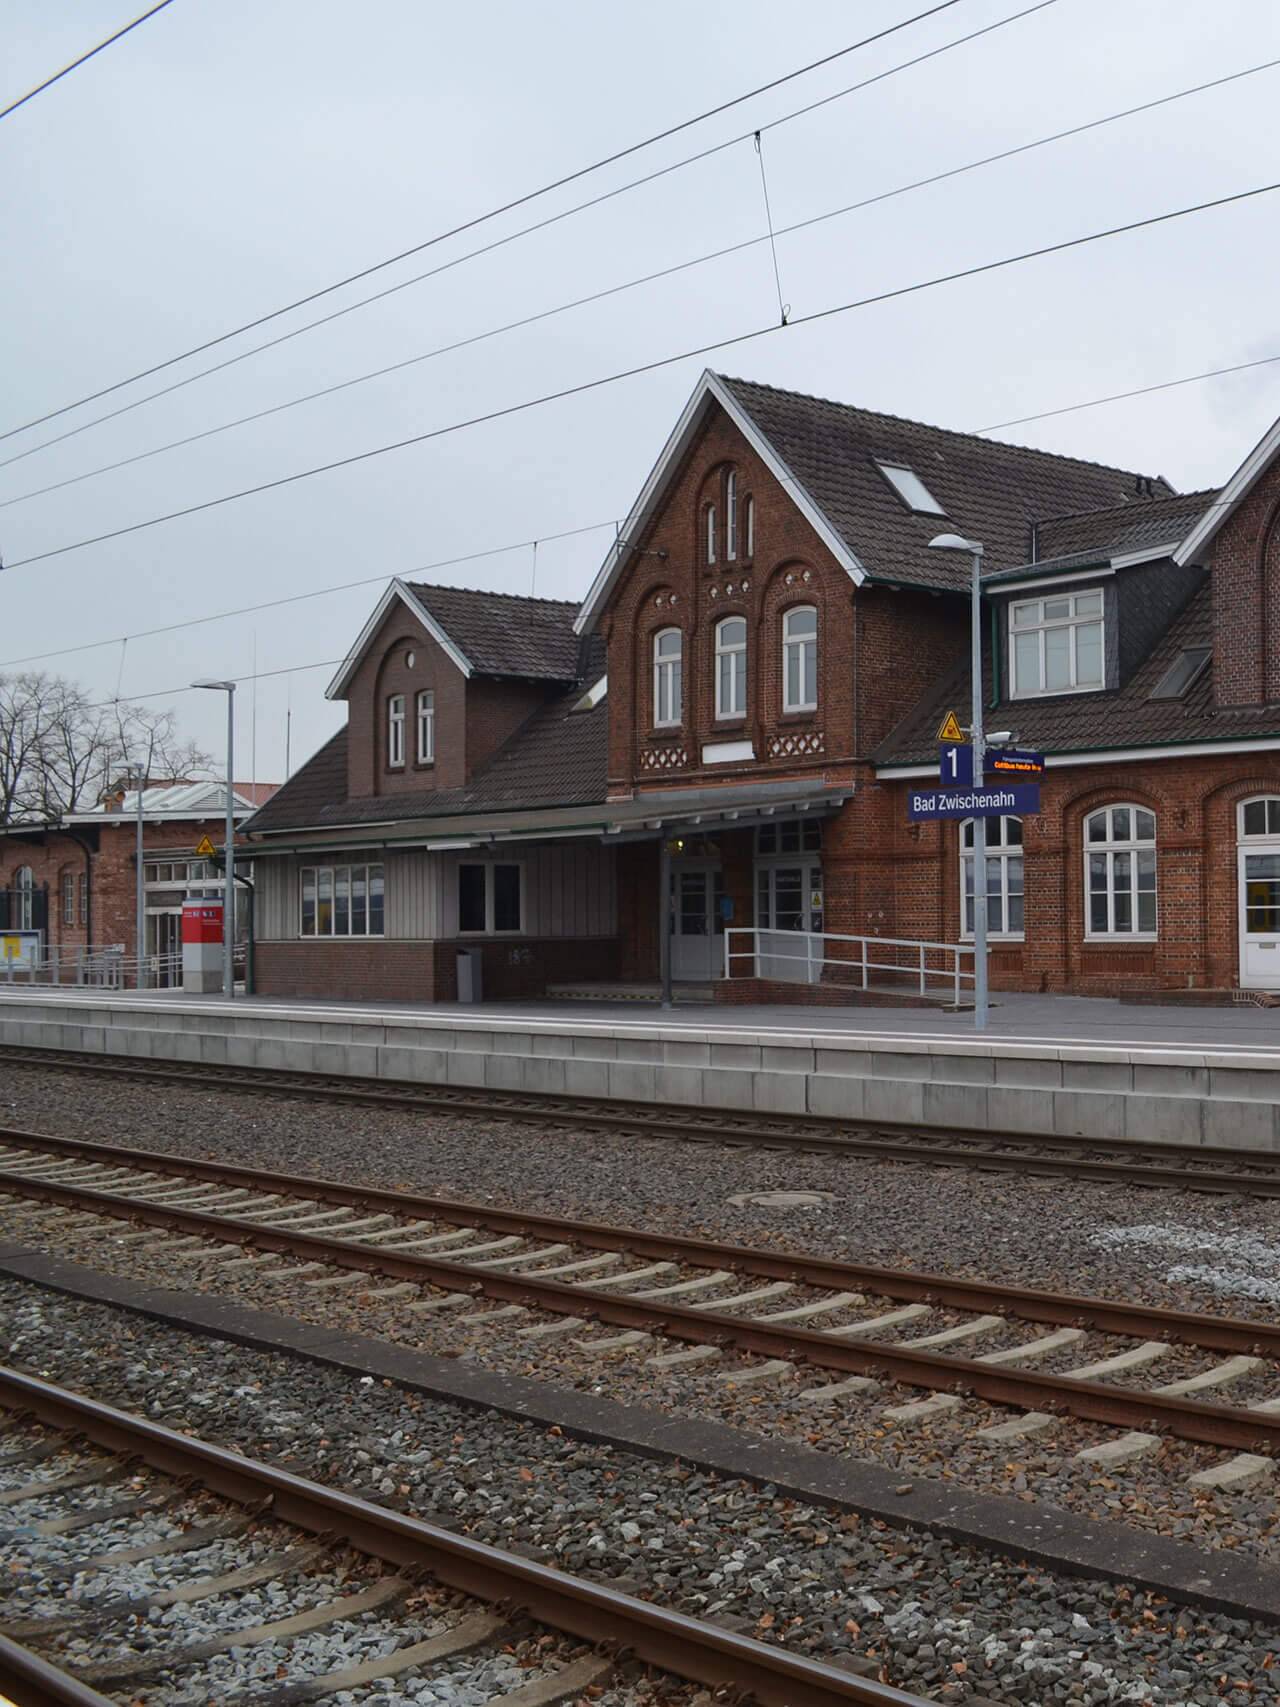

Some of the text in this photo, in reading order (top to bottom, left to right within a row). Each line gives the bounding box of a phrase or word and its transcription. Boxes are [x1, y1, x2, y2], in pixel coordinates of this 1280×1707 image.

[947, 748, 957, 777] 1
[913, 791, 1015, 812] Bad Zwischenahn
